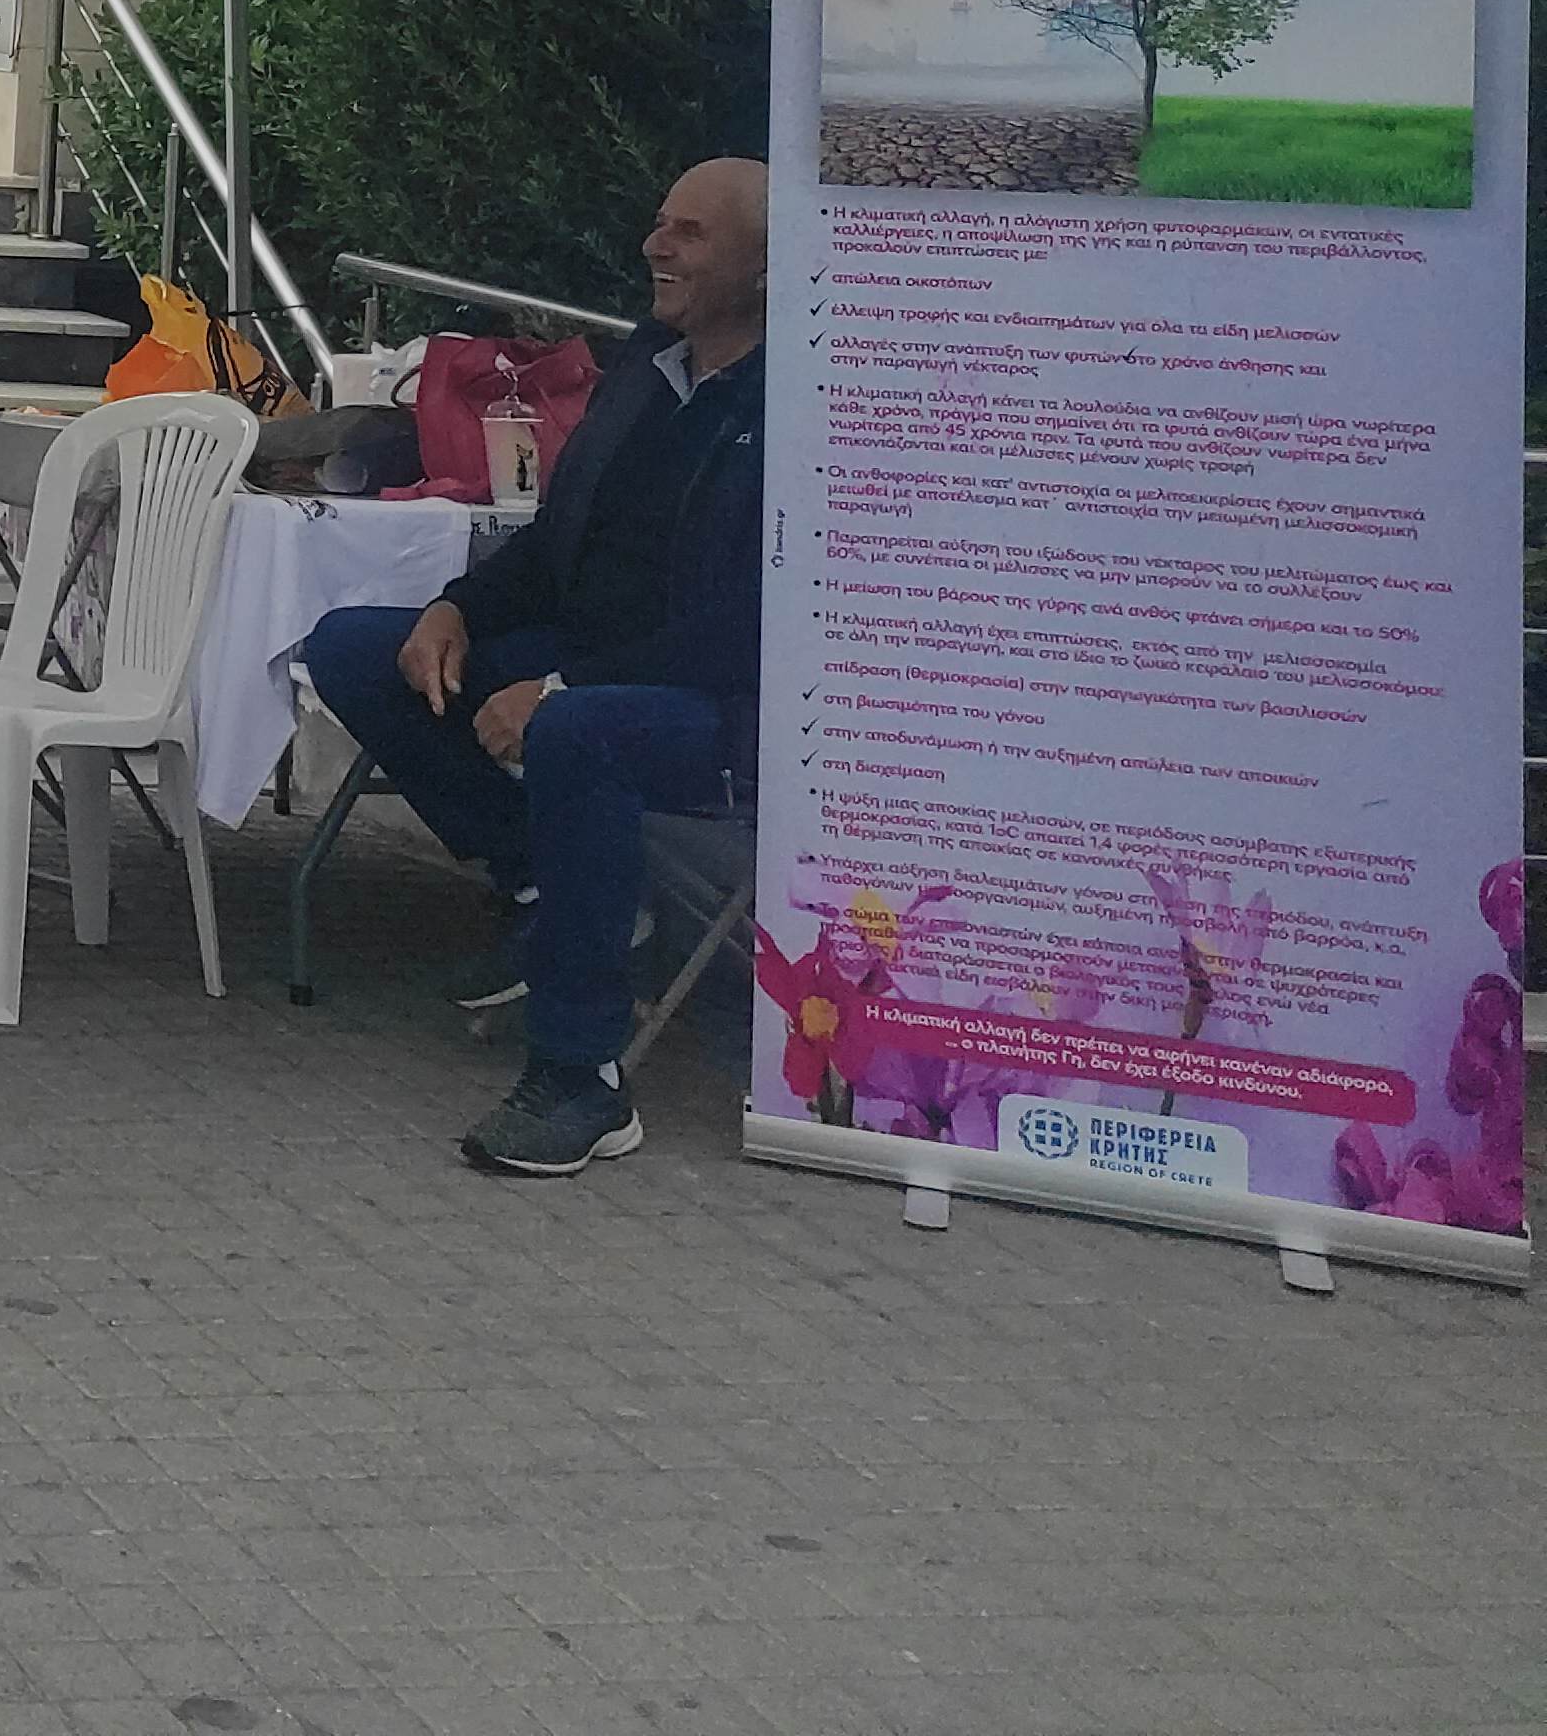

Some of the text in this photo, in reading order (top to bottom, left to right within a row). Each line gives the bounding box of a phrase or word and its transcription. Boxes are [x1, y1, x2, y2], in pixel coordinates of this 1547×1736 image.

[833, 206, 846, 220] Η
[851, 208, 927, 226] κλιματική
[999, 217, 1009, 229] η
[1013, 215, 1090, 234] αλόγιστη
[1094, 217, 1148, 235] χρήση
[1298, 228, 1315, 240] οι
[1319, 227, 1404, 245] εντατικές
[832, 240, 922, 257] προκαλούν
[926, 244, 1020, 262] επιπτώσεις
[831, 272, 993, 291] απώλεια οικοτόπων
[823, 692, 1046, 727] στη βιωσιμότητα του γόνου
[866, 1004, 1394, 1097] Η κλιματική αλλαγή δεν πρέπει να αφήνει κανέναν αδιάφορο,
[961, 1038, 1302, 1099] ο πλανήτης Γη, δεν έχει έξοδο κινδύνου.
[1089, 1136, 1169, 1167] ΚΡΗΤΗΣ
[1090, 1116, 1218, 1154] ΠΕΡΙΦΕΡΕΙΑ
[1089, 1157, 1214, 1188] REGION OF CRETE
